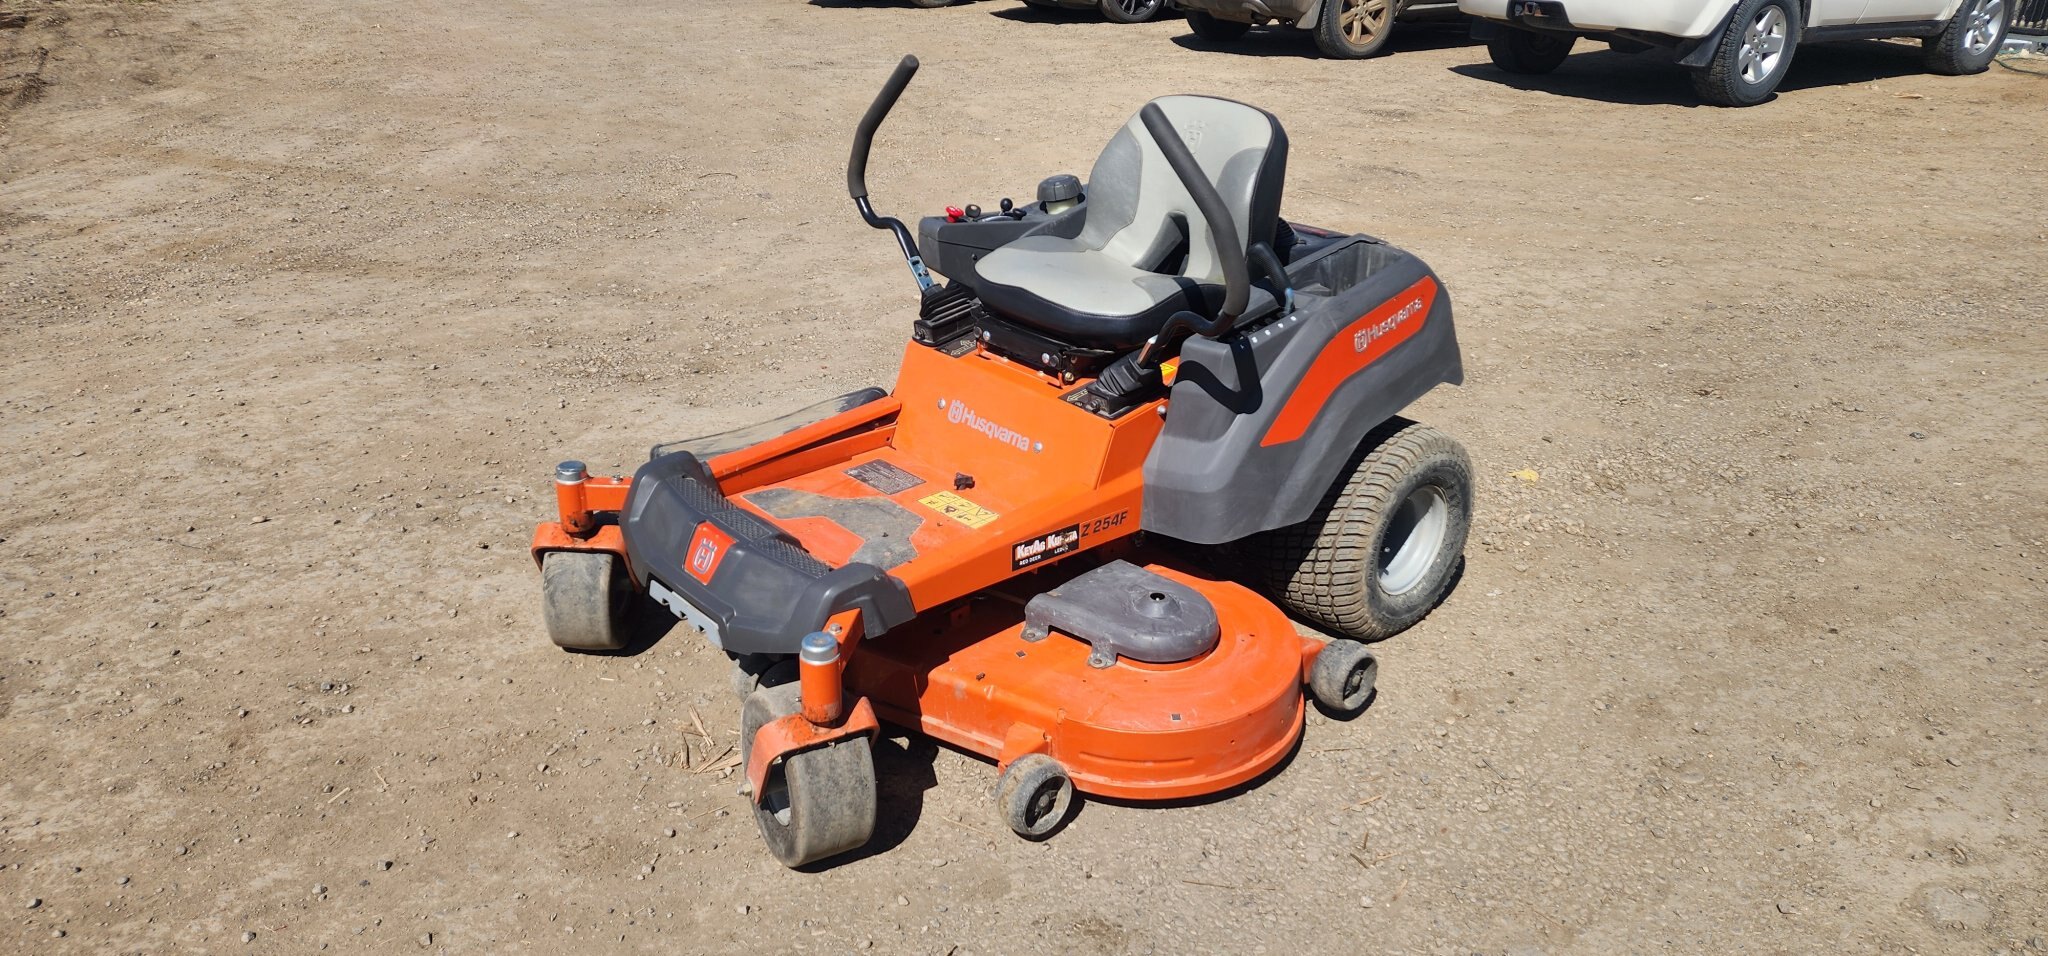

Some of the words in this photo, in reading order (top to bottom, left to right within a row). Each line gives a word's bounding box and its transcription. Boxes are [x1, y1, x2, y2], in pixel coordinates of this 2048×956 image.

[1367, 297, 1423, 343] Husqvarna
[961, 406, 1030, 452] Husqvarna
[1081, 523, 1092, 538] Z
[1093, 510, 1128, 534] 254F
